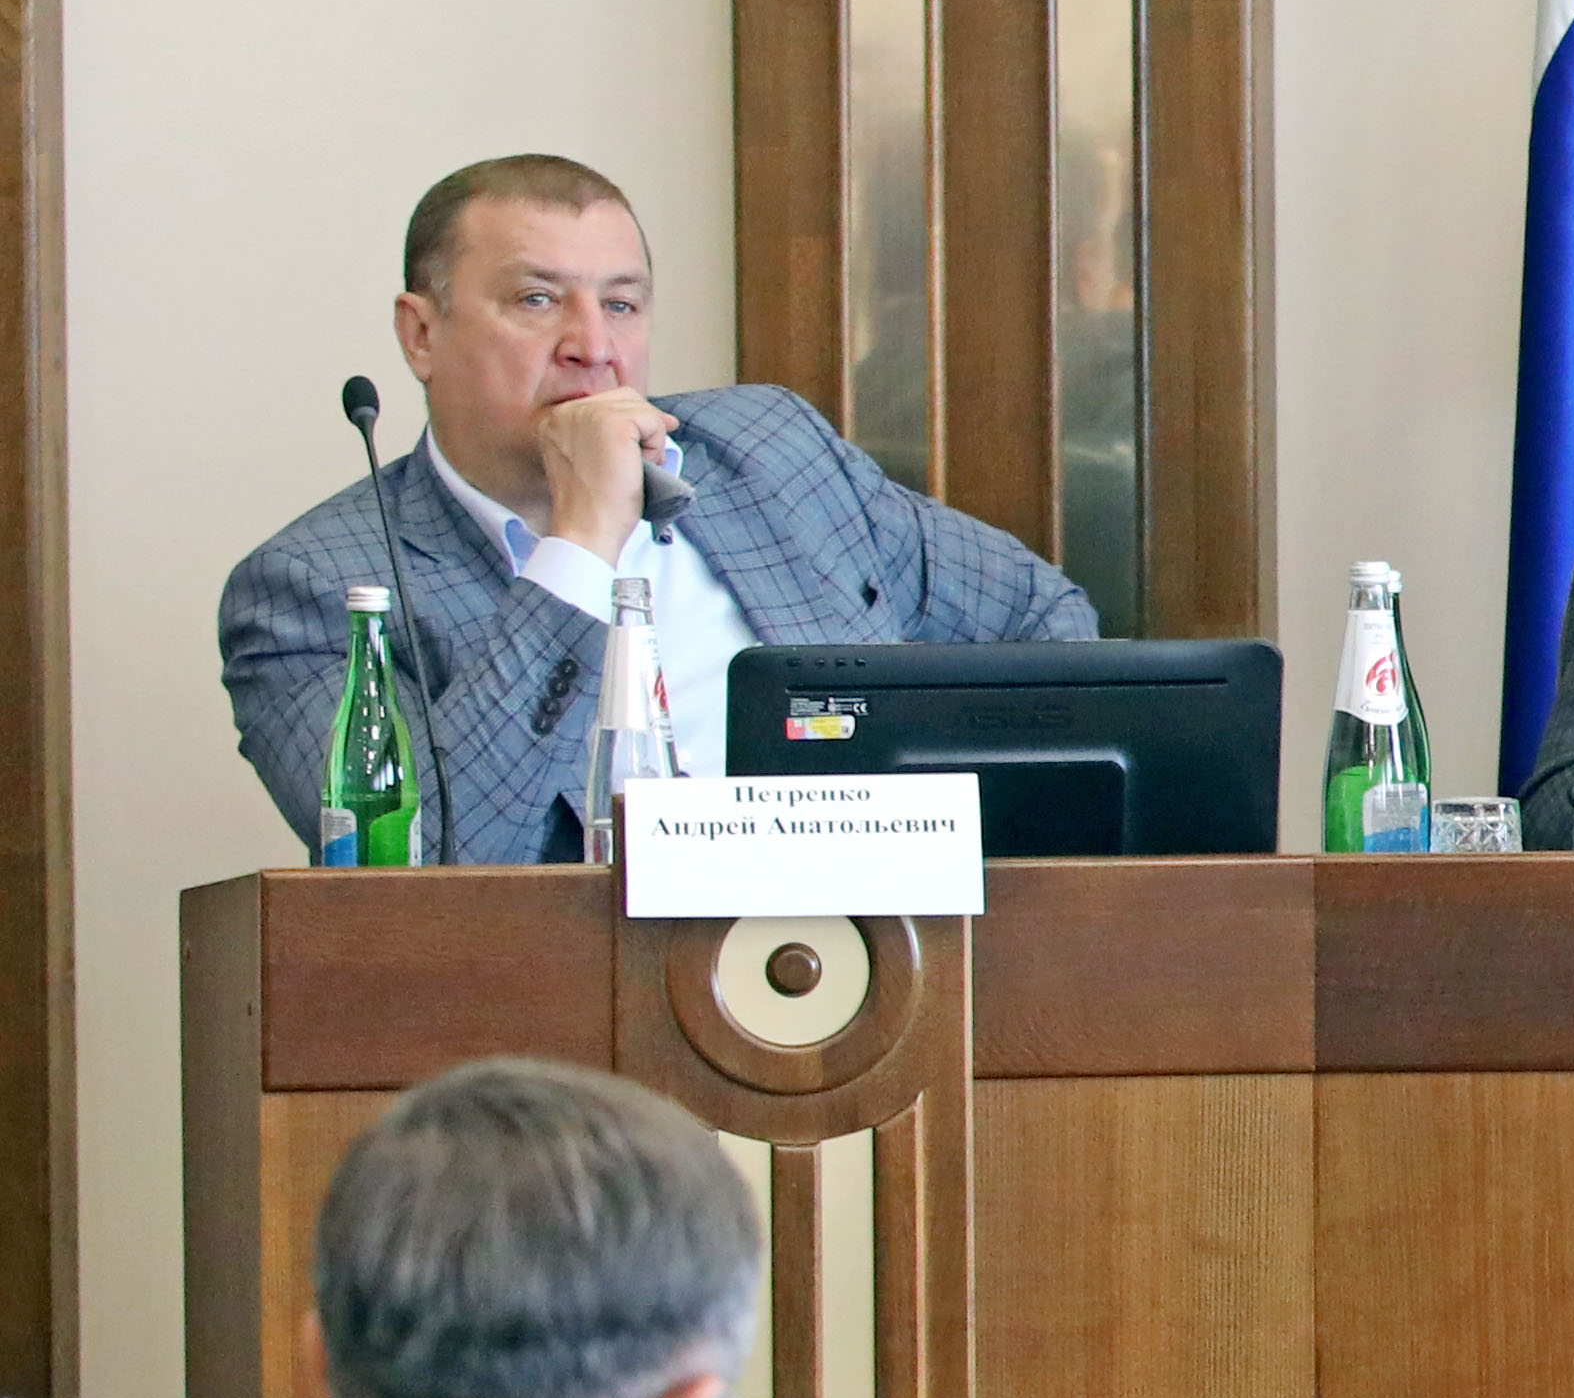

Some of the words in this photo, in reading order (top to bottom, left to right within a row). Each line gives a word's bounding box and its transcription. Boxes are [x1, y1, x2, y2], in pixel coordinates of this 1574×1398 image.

[735, 785, 871, 808] Петренко
[652, 816, 756, 842] Андрей
[767, 816, 956, 835] Анатольевич
